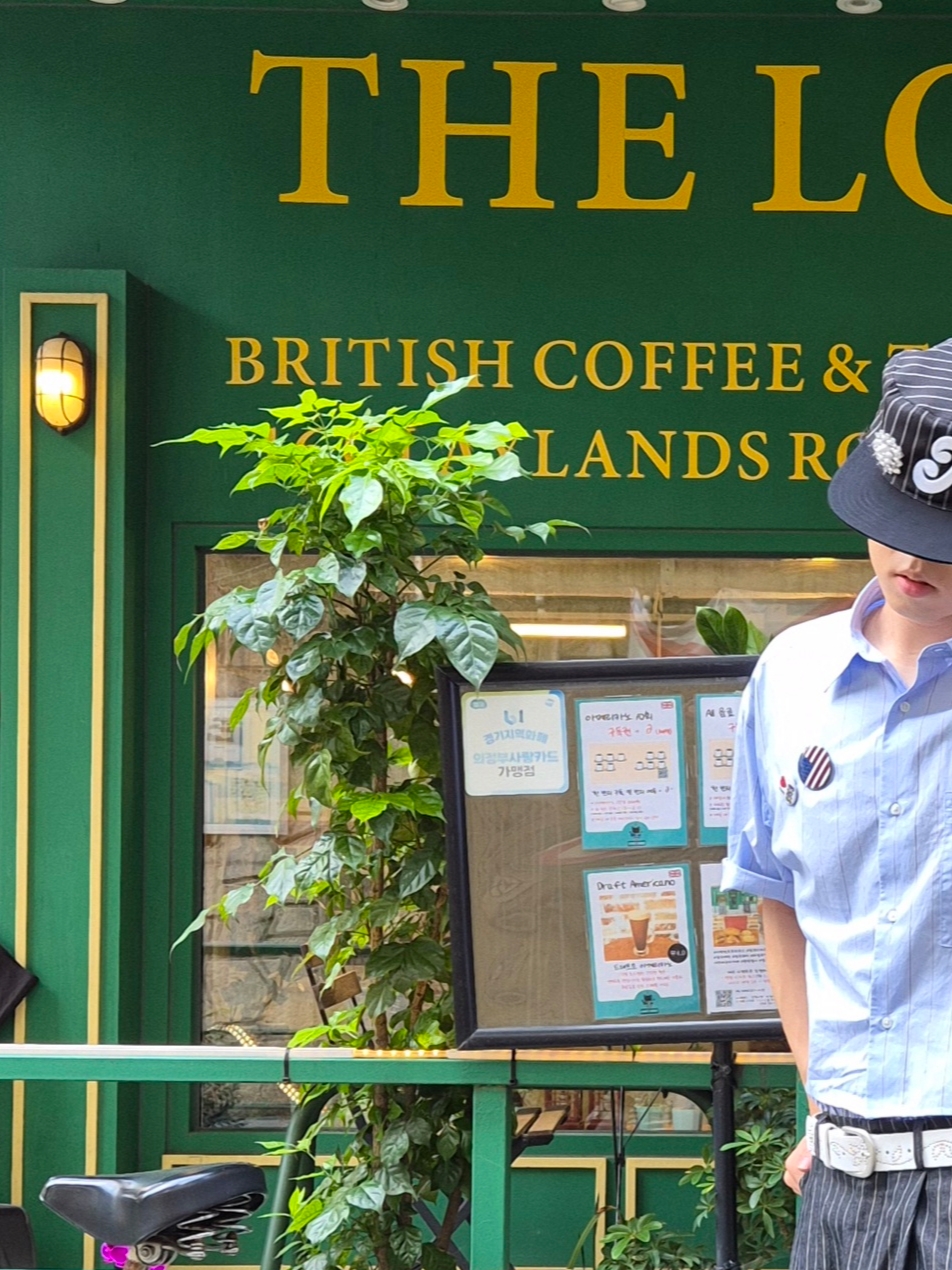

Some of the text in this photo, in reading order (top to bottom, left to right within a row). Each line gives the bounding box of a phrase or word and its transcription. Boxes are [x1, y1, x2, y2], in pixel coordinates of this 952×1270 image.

[250, 50, 696, 210] THE
[227, 336, 513, 389] BRITISH
[533, 341, 805, 393] COFFEE
[822, 343, 873, 394] &
[472, 750, 560, 765] 의정부사랑카드
[498, 765, 536, 778] 가맹점
[596, 878, 677, 891] Draft Americano
